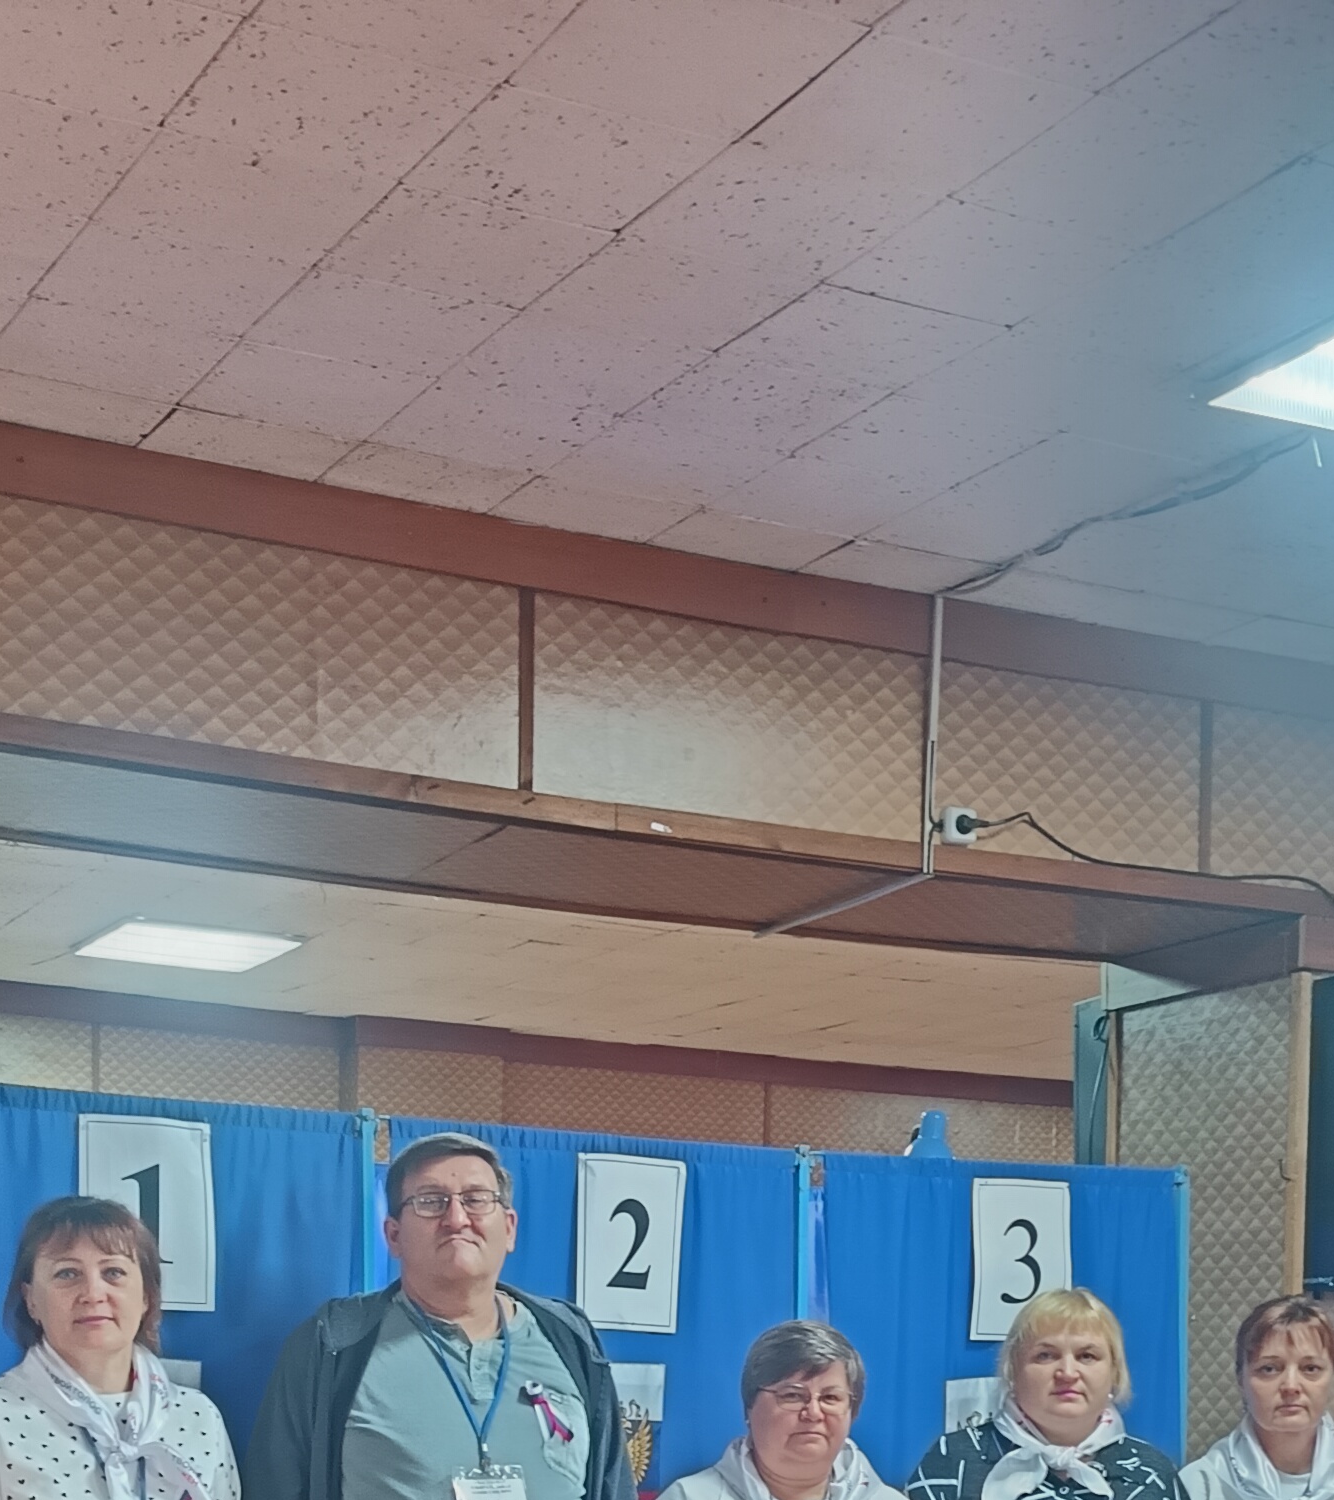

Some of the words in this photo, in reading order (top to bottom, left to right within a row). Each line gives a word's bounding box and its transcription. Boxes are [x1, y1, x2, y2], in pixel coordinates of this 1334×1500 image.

[121, 1164, 174, 1264] 1
[607, 1198, 651, 1290] 2
[1001, 1219, 1042, 1303] 3
